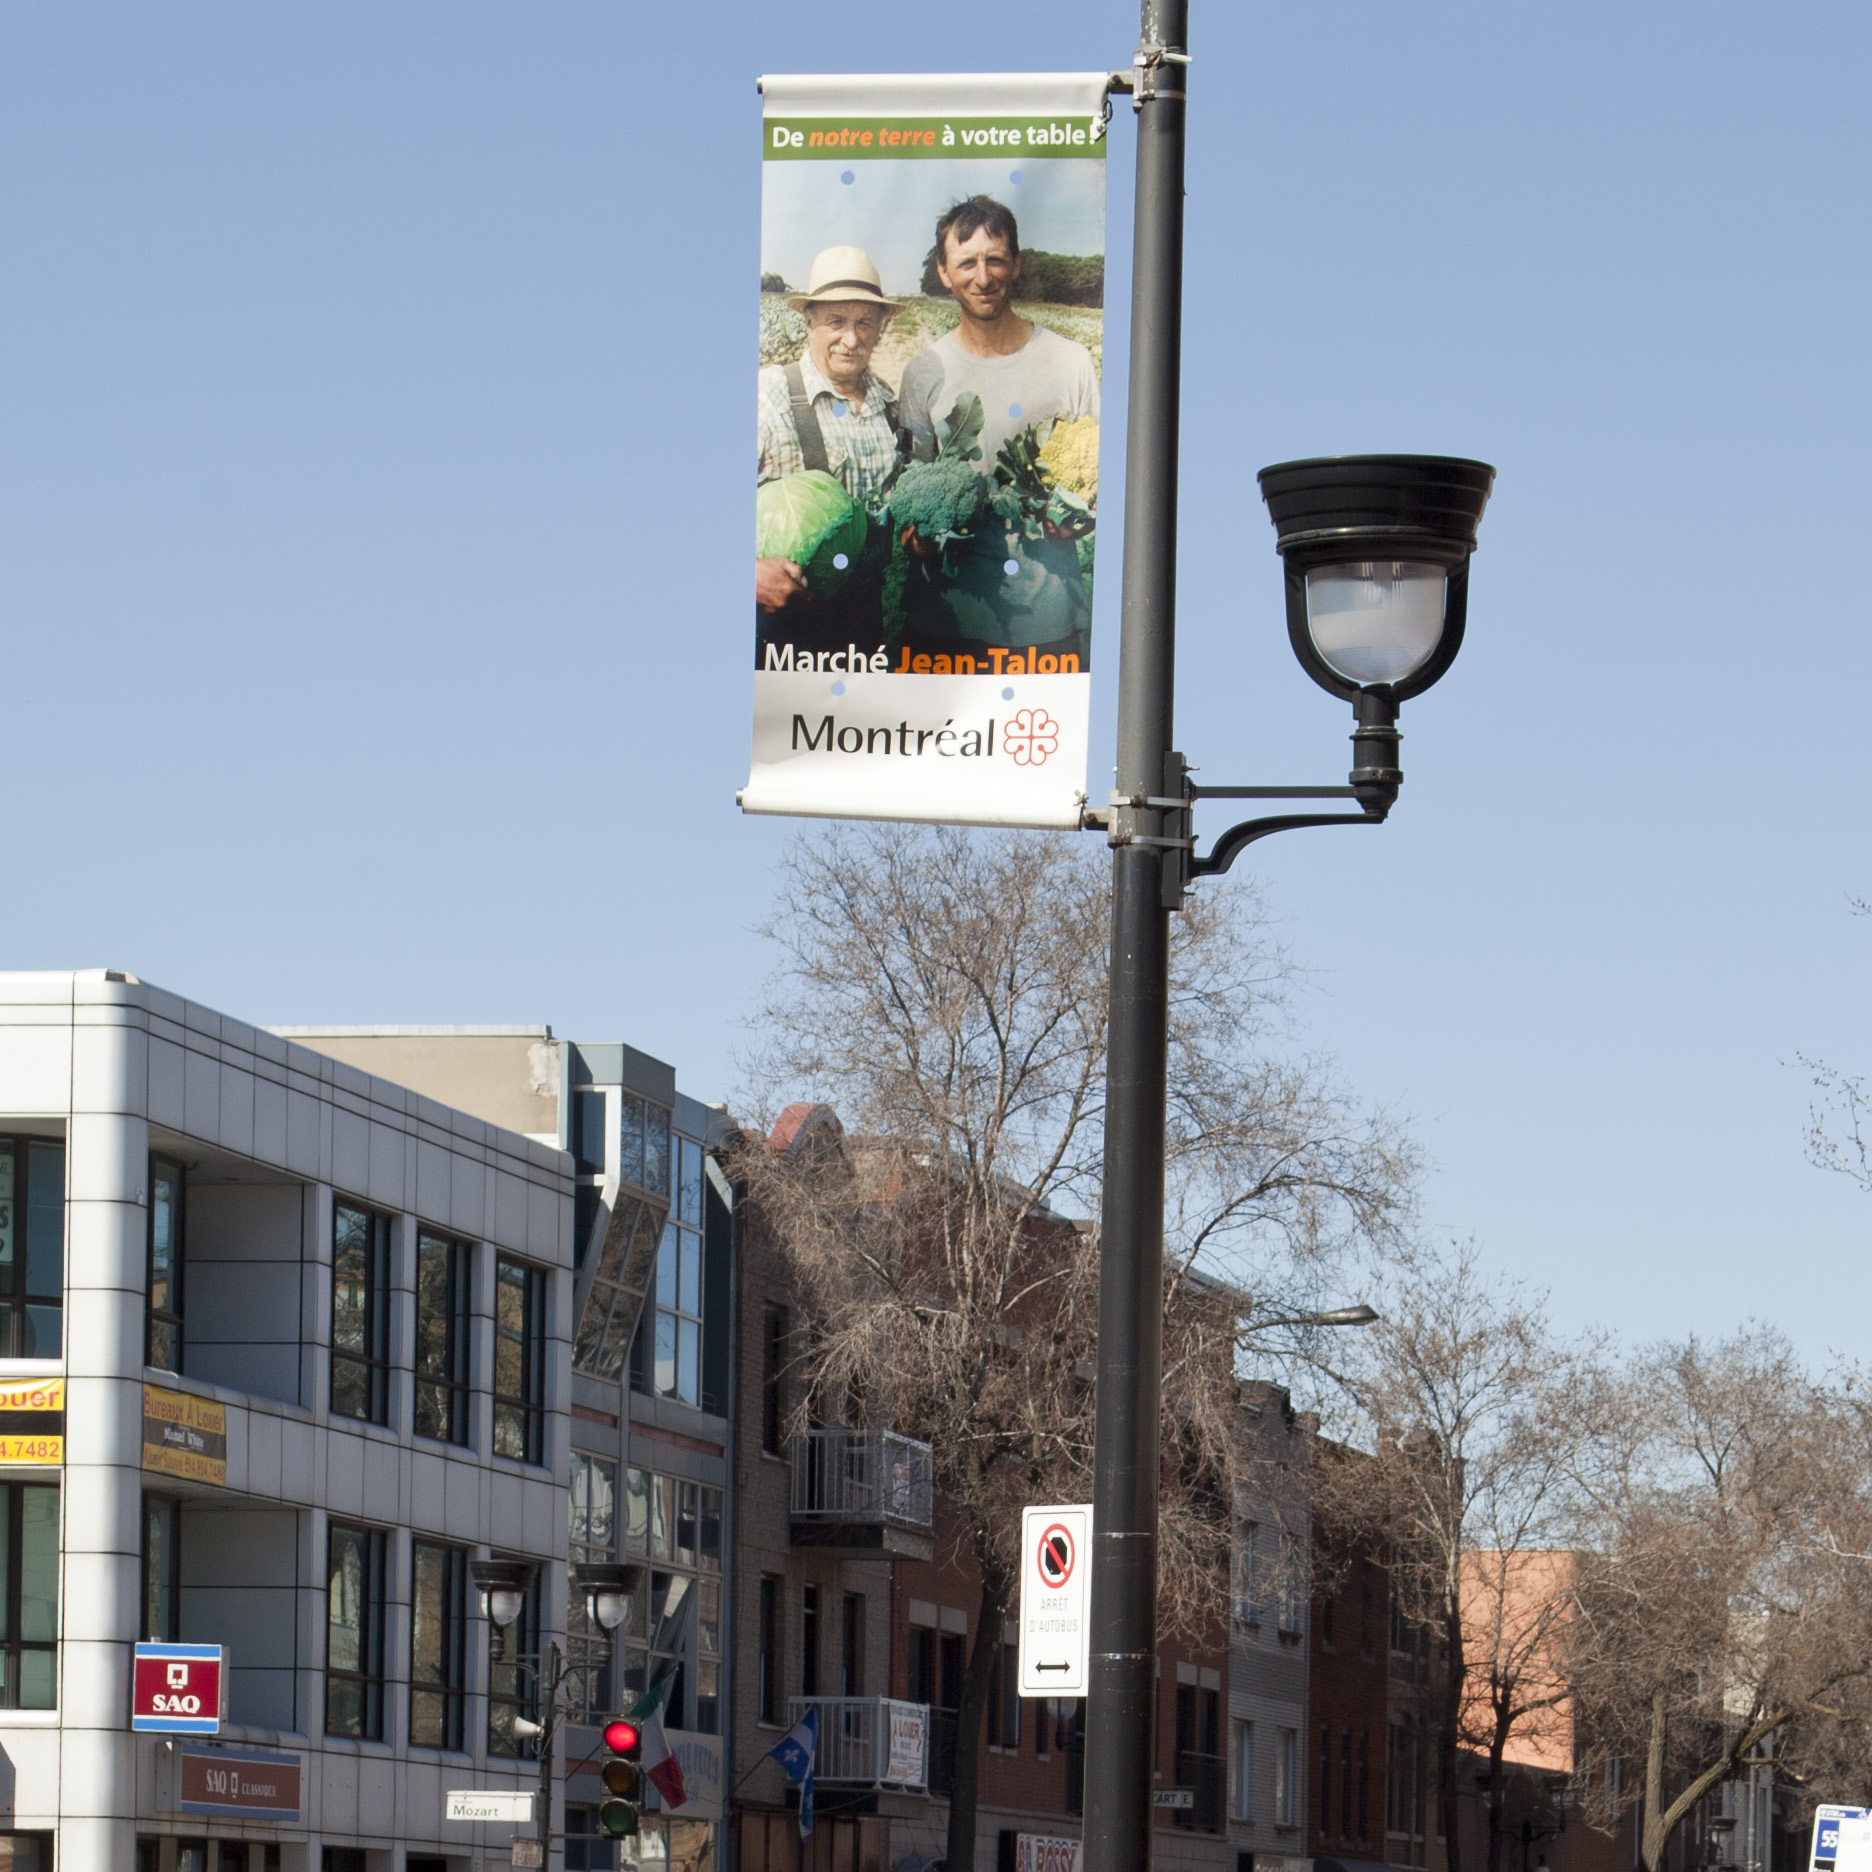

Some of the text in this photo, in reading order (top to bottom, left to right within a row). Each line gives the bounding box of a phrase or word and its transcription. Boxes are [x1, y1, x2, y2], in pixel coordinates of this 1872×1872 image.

[772, 126, 804, 148] De
[808, 126, 873, 147] notre
[878, 126, 936, 146] terre
[941, 123, 955, 146] à
[961, 127, 1022, 146] votre
[764, 643, 1079, 675] Marché Jean-Talon
[791, 713, 994, 757] Montréal
[1040, 1596, 1068, 1611] ARRÊT
[1029, 1619, 1078, 1633] D'AUTOBUS
[152, 1694, 201, 1714] SAQ
[206, 1768, 277, 1797] SAQ CLASSIQUE
[453, 1805, 499, 1817] Mozart
[1821, 1830, 1839, 1848] 55
